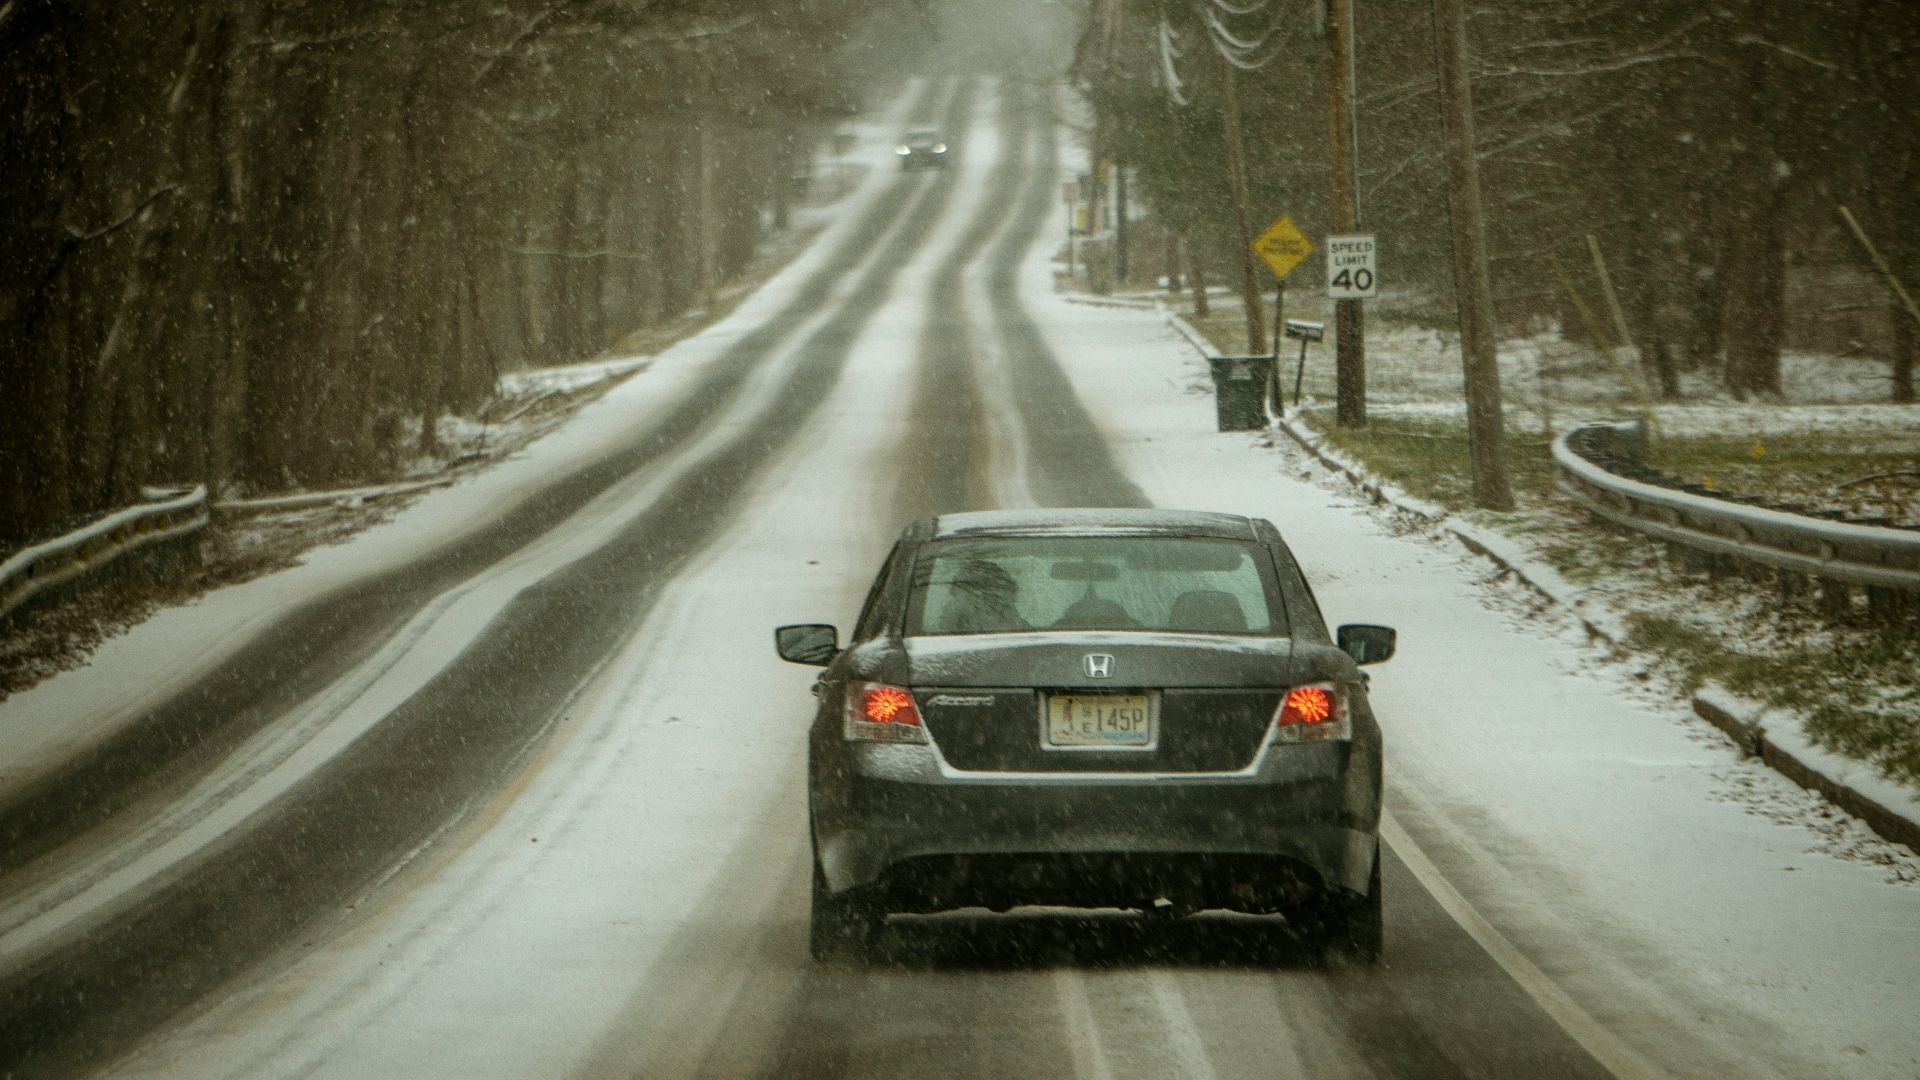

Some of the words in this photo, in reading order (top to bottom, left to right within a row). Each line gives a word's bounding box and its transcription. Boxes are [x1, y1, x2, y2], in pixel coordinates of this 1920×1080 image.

[1331, 242, 1373, 253] SPEED
[1335, 256, 1367, 266] LIMIT
[1332, 268, 1373, 291] 40
